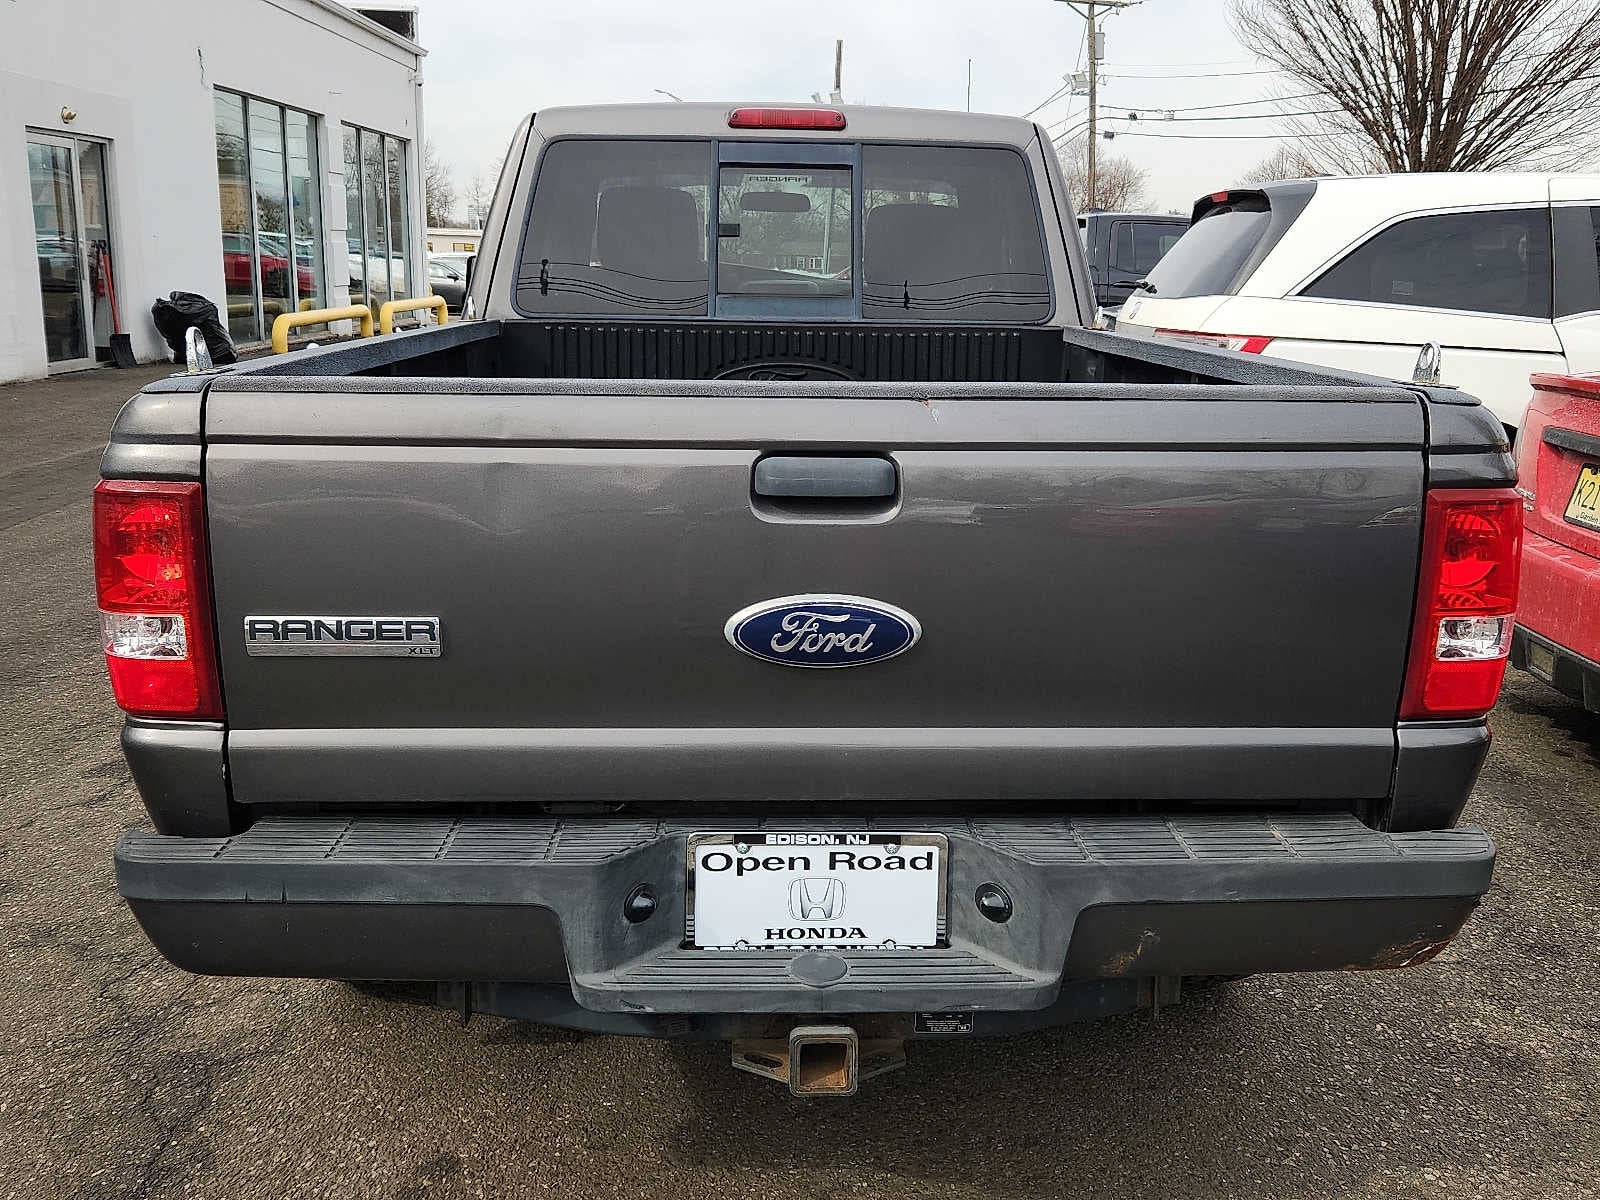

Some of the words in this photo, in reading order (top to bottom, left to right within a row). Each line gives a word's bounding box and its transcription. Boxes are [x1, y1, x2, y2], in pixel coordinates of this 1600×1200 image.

[249, 619, 437, 642] RANGER
[770, 611, 877, 653] Ford
[408, 647, 438, 655] XLT
[846, 834, 870, 845] NJ
[701, 851, 811, 876] Open
[828, 851, 934, 871] Road
[763, 927, 869, 940] HONDA
